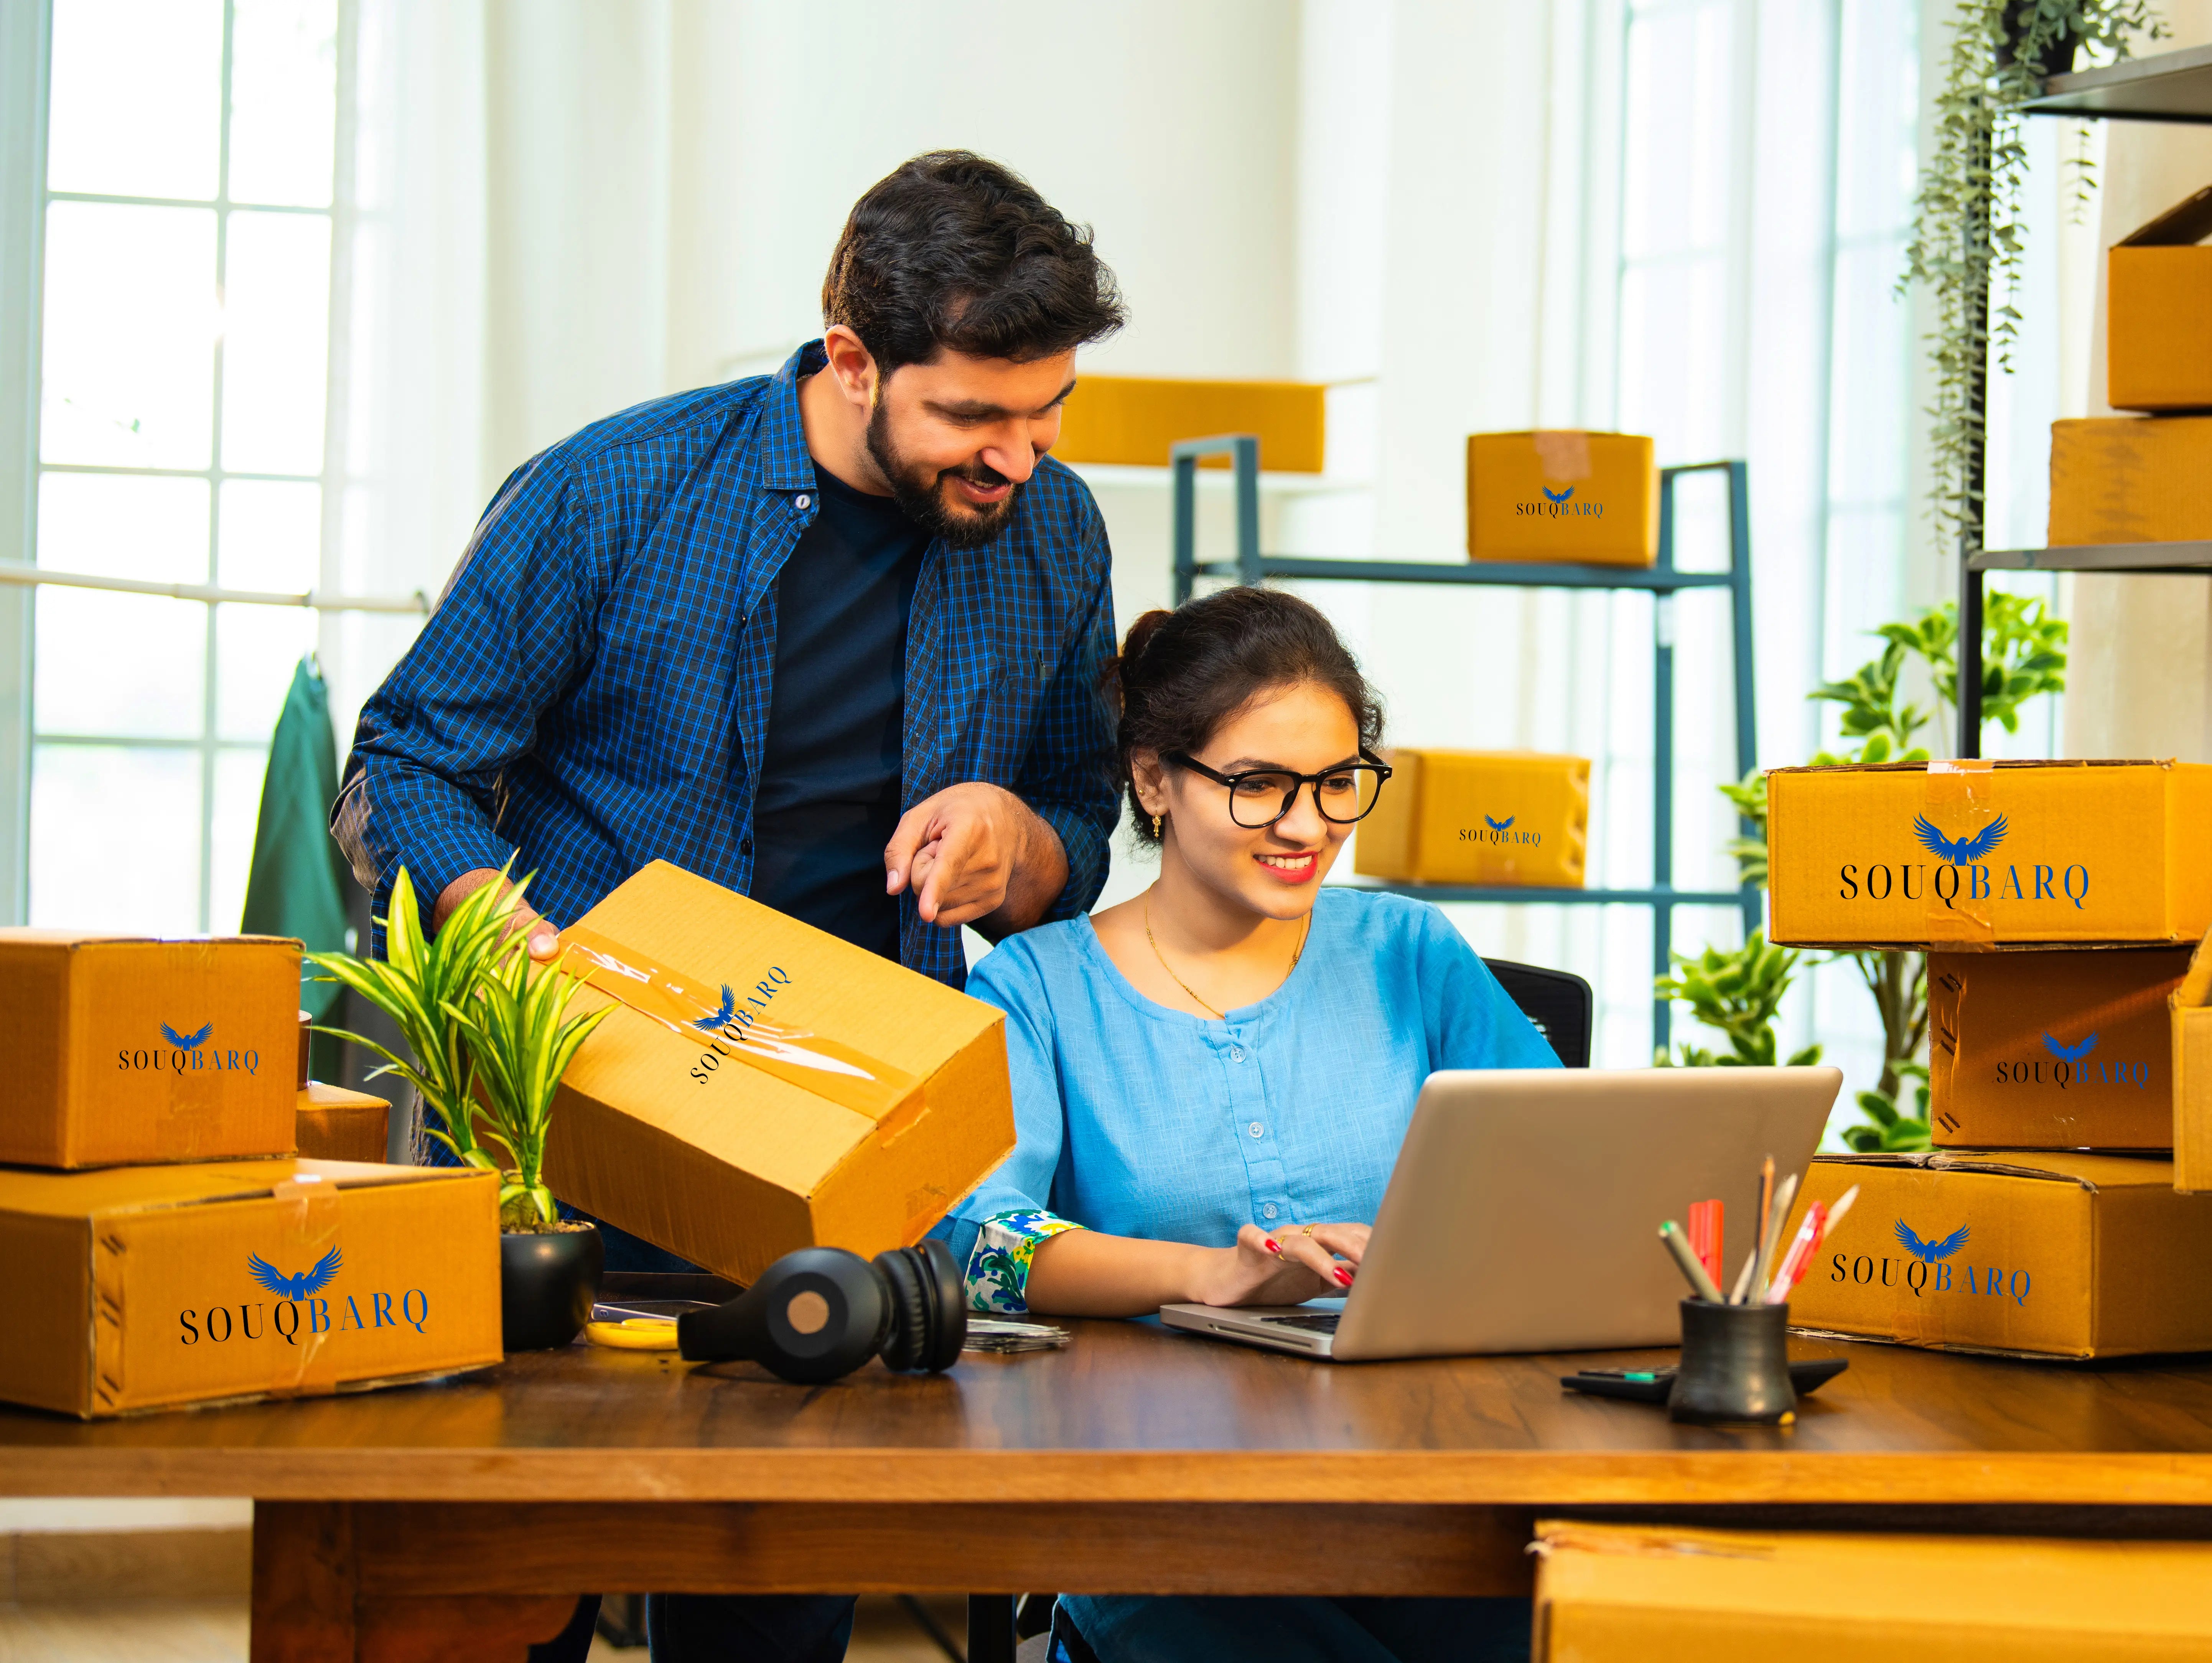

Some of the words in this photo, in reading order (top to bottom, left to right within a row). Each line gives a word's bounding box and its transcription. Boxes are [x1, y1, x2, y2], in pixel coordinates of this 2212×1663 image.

[1517, 503, 1603, 519] SOUQBARQ
[1459, 829, 1541, 847] SOUQBARQ
[1839, 864, 2090, 910] SOUQBARQ
[690, 966, 792, 1084] SOUQBARQ
[118, 1050, 259, 1076] SOUQBARQ
[1996, 1061, 2149, 1089] SOUQBARQ
[1831, 1253, 2031, 1307] SOUQBARQ
[179, 1288, 428, 1345] SOUQBARQ
